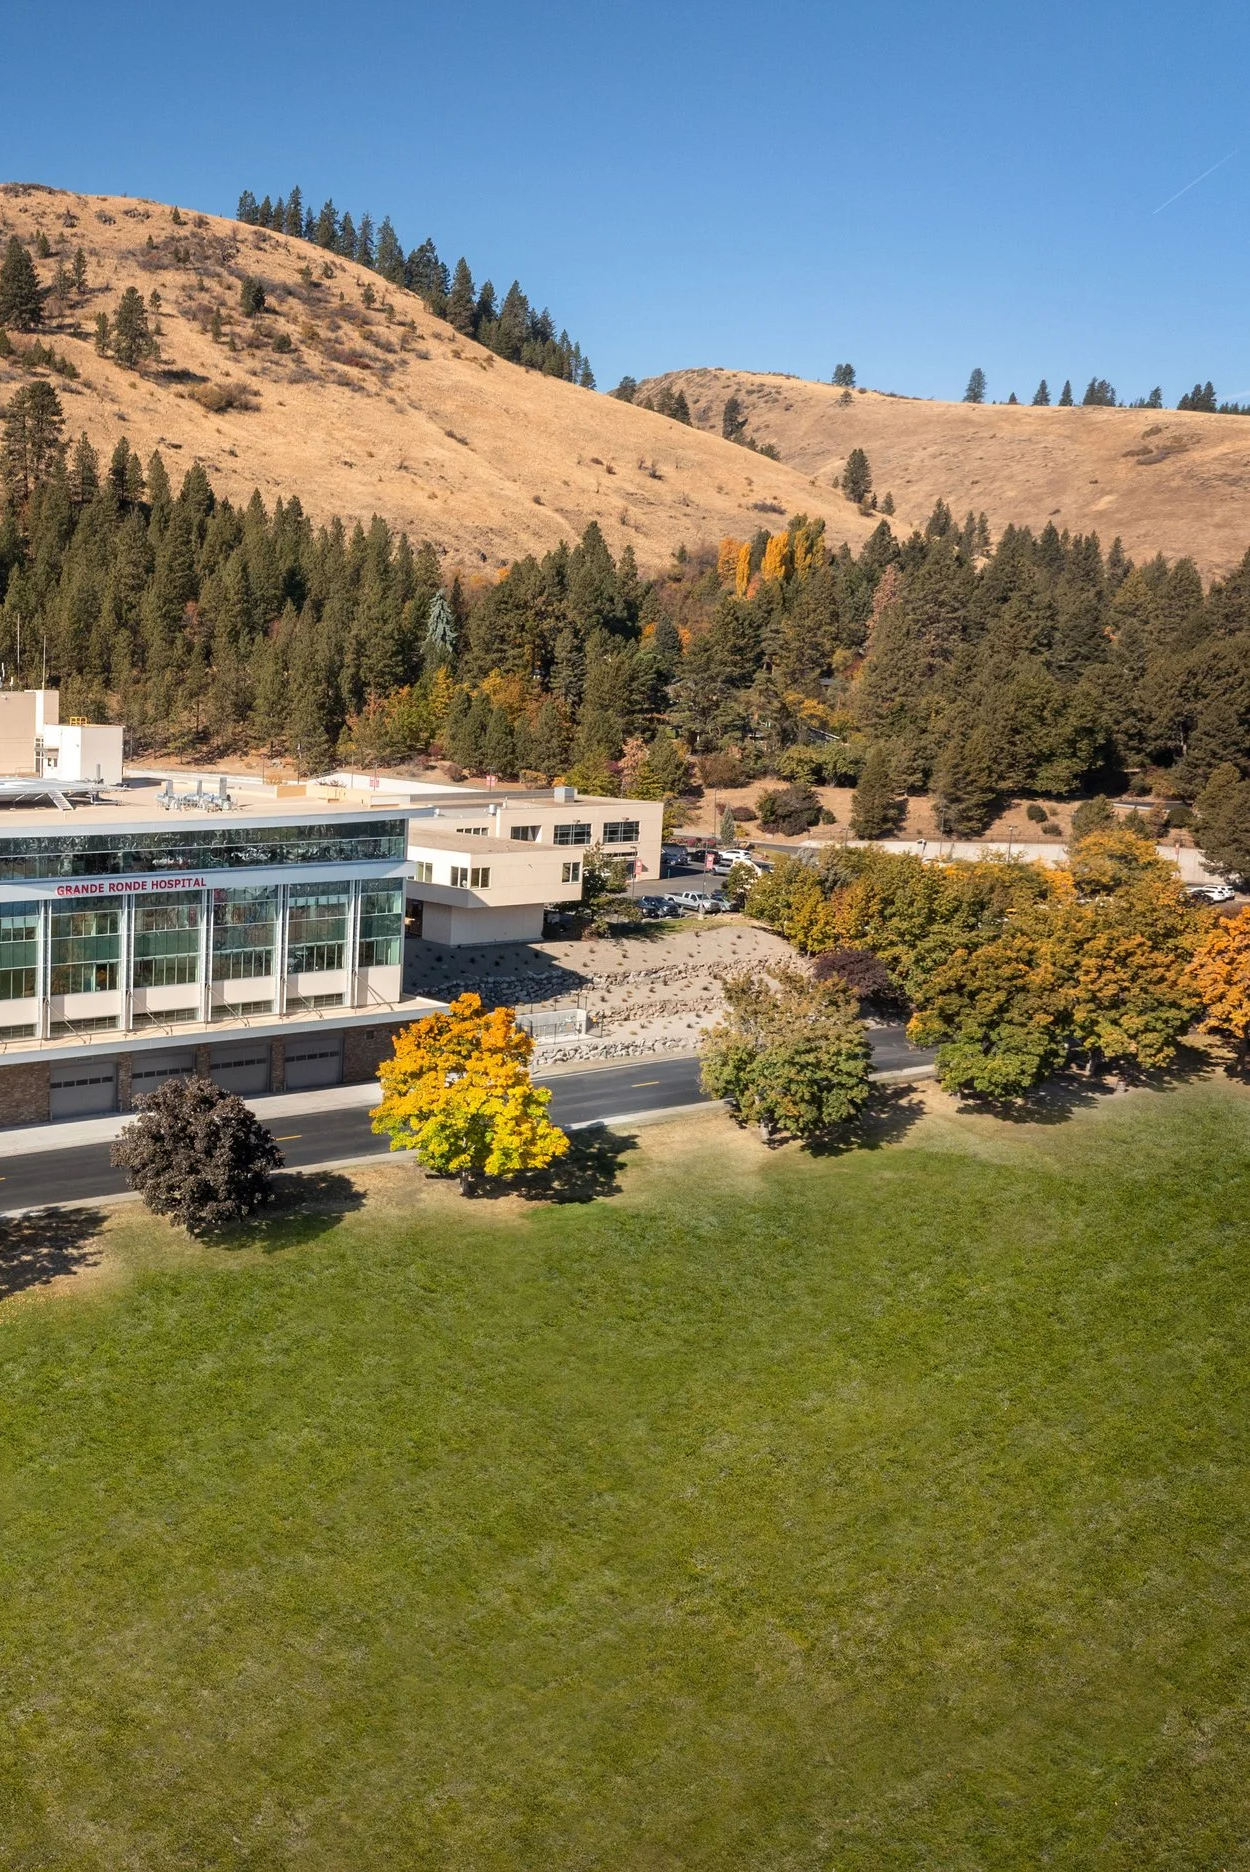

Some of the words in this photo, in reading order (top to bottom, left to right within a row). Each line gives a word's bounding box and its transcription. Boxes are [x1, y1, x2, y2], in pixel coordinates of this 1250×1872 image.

[56, 883, 105, 896] GRANDE
[108, 881, 147, 892] RONDE
[151, 877, 207, 890] HOSPITAL
